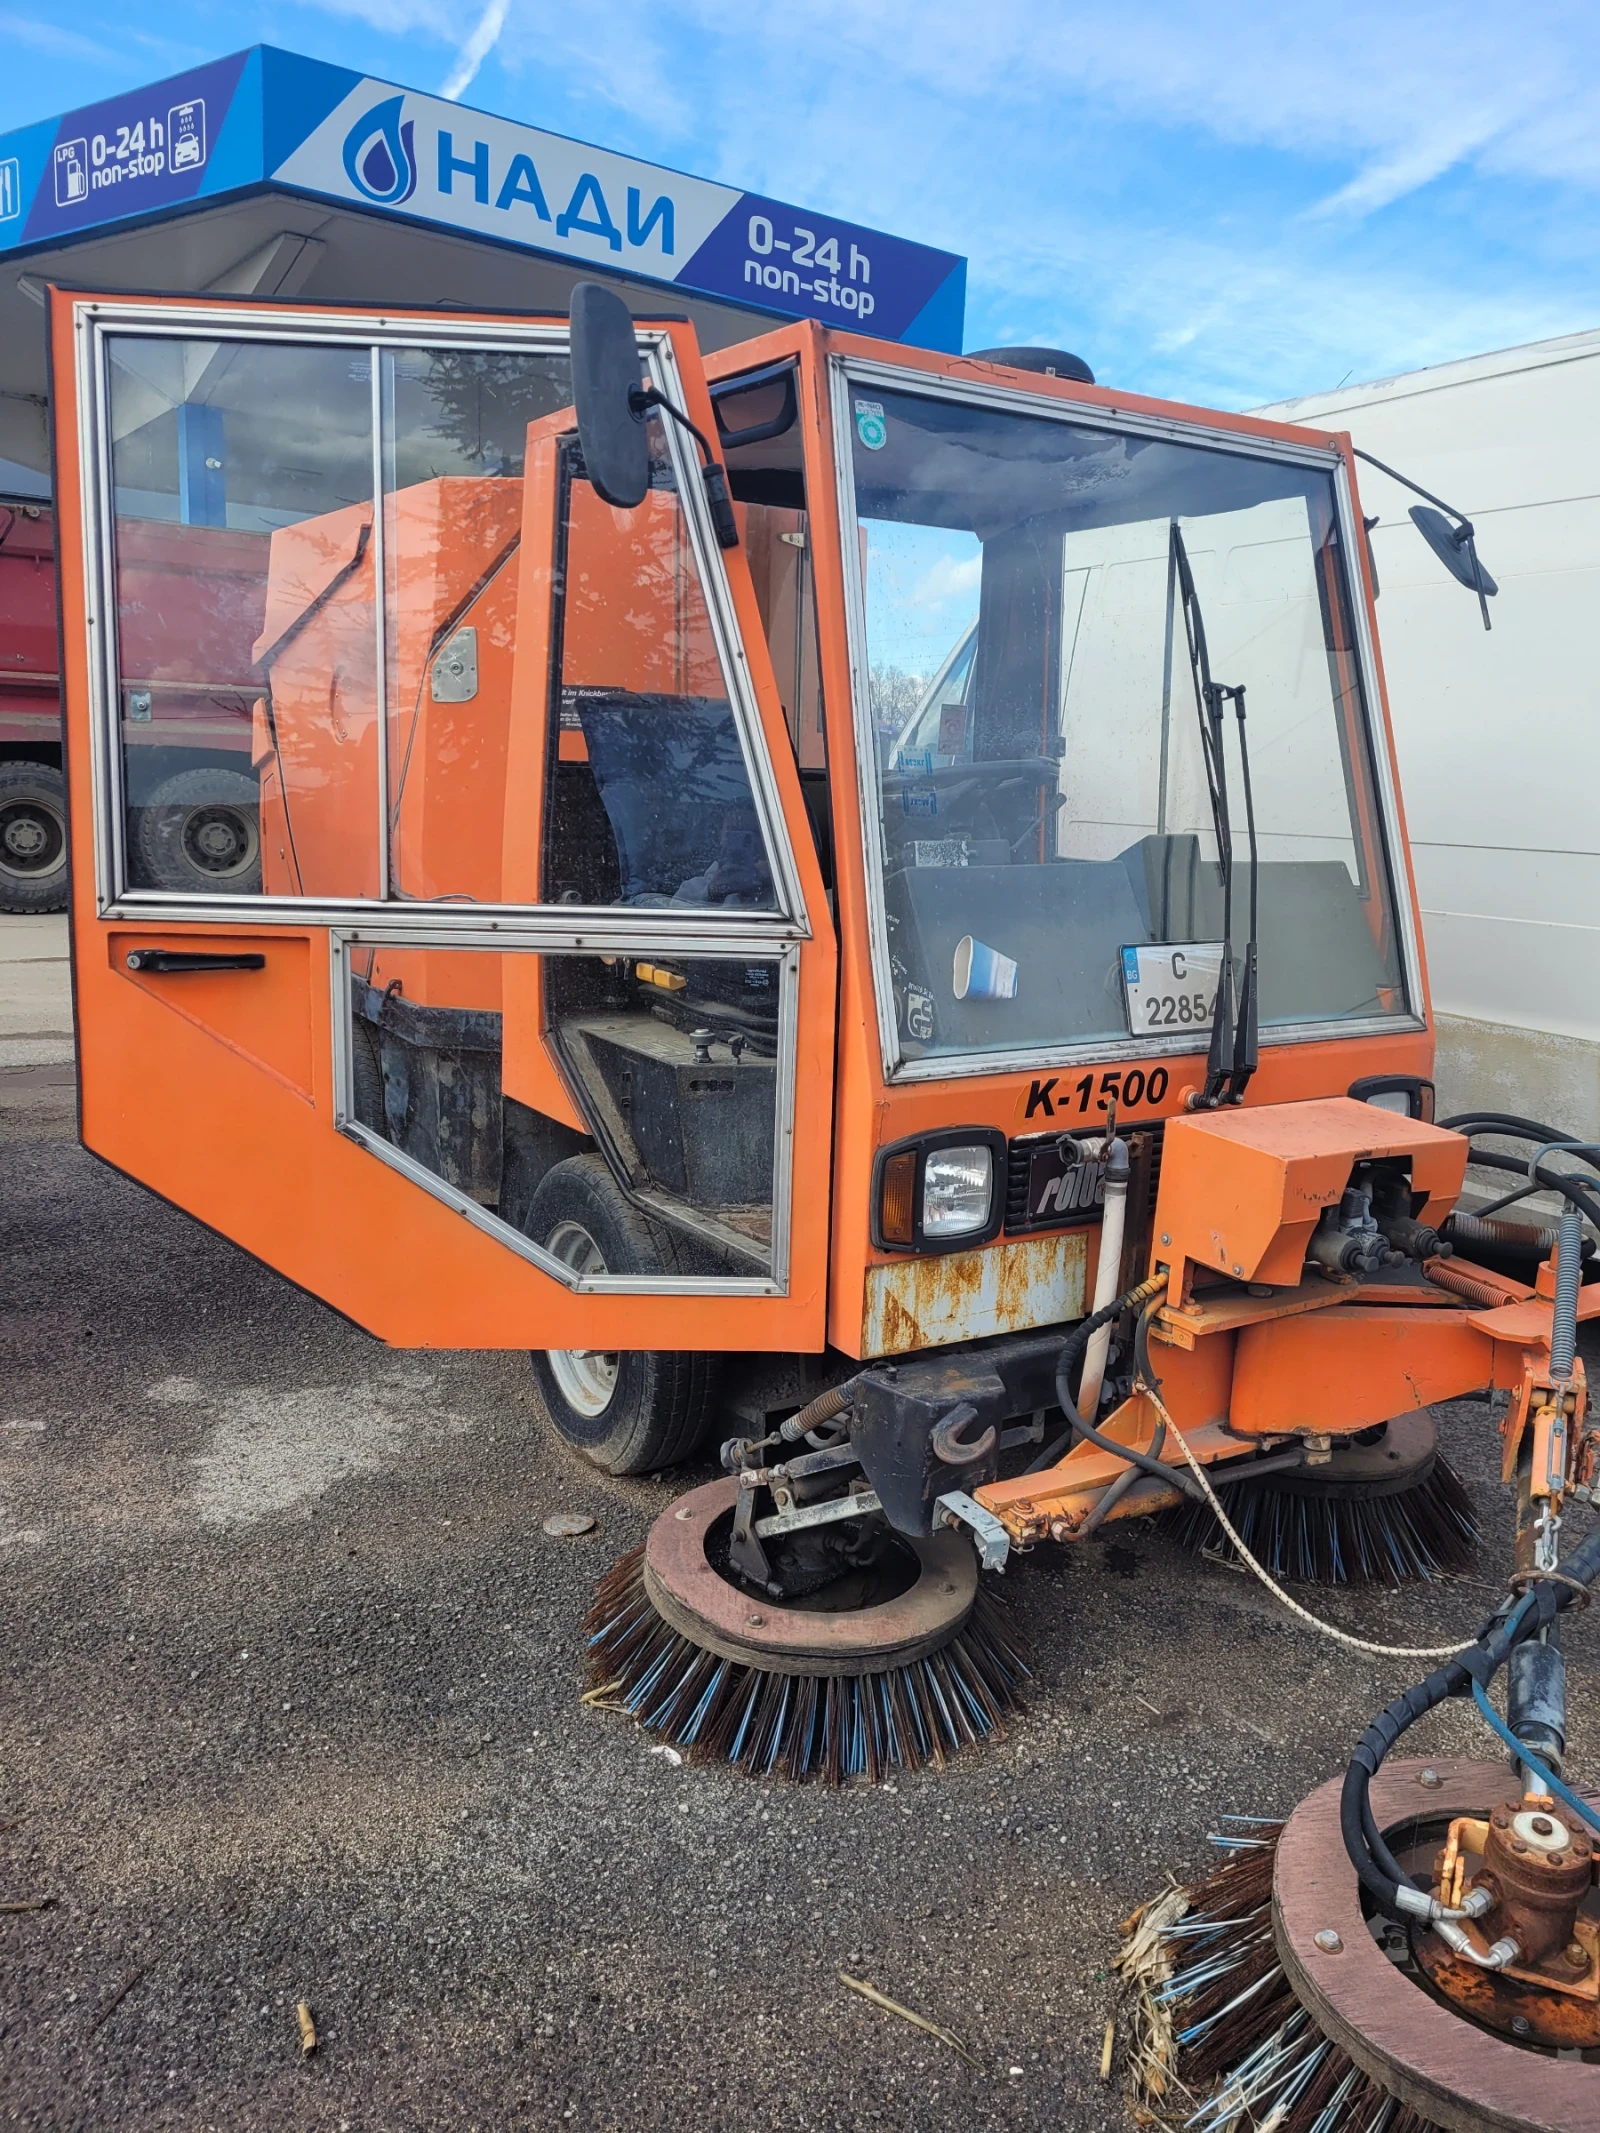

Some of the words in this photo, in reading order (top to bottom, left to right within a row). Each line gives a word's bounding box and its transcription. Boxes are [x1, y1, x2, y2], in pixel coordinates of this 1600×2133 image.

[57, 146, 76, 162] LPG
[91, 120, 146, 167] 0-24
[150, 117, 164, 148] h
[92, 151, 165, 190] non-stop
[437, 130, 676, 256] НАДИ
[748, 215, 841, 275] 0-24
[850, 244, 871, 284] h
[744, 258, 876, 319] non-stop
[1126, 970, 1138, 980] BG
[1024, 1066, 1169, 1119] K-1500
